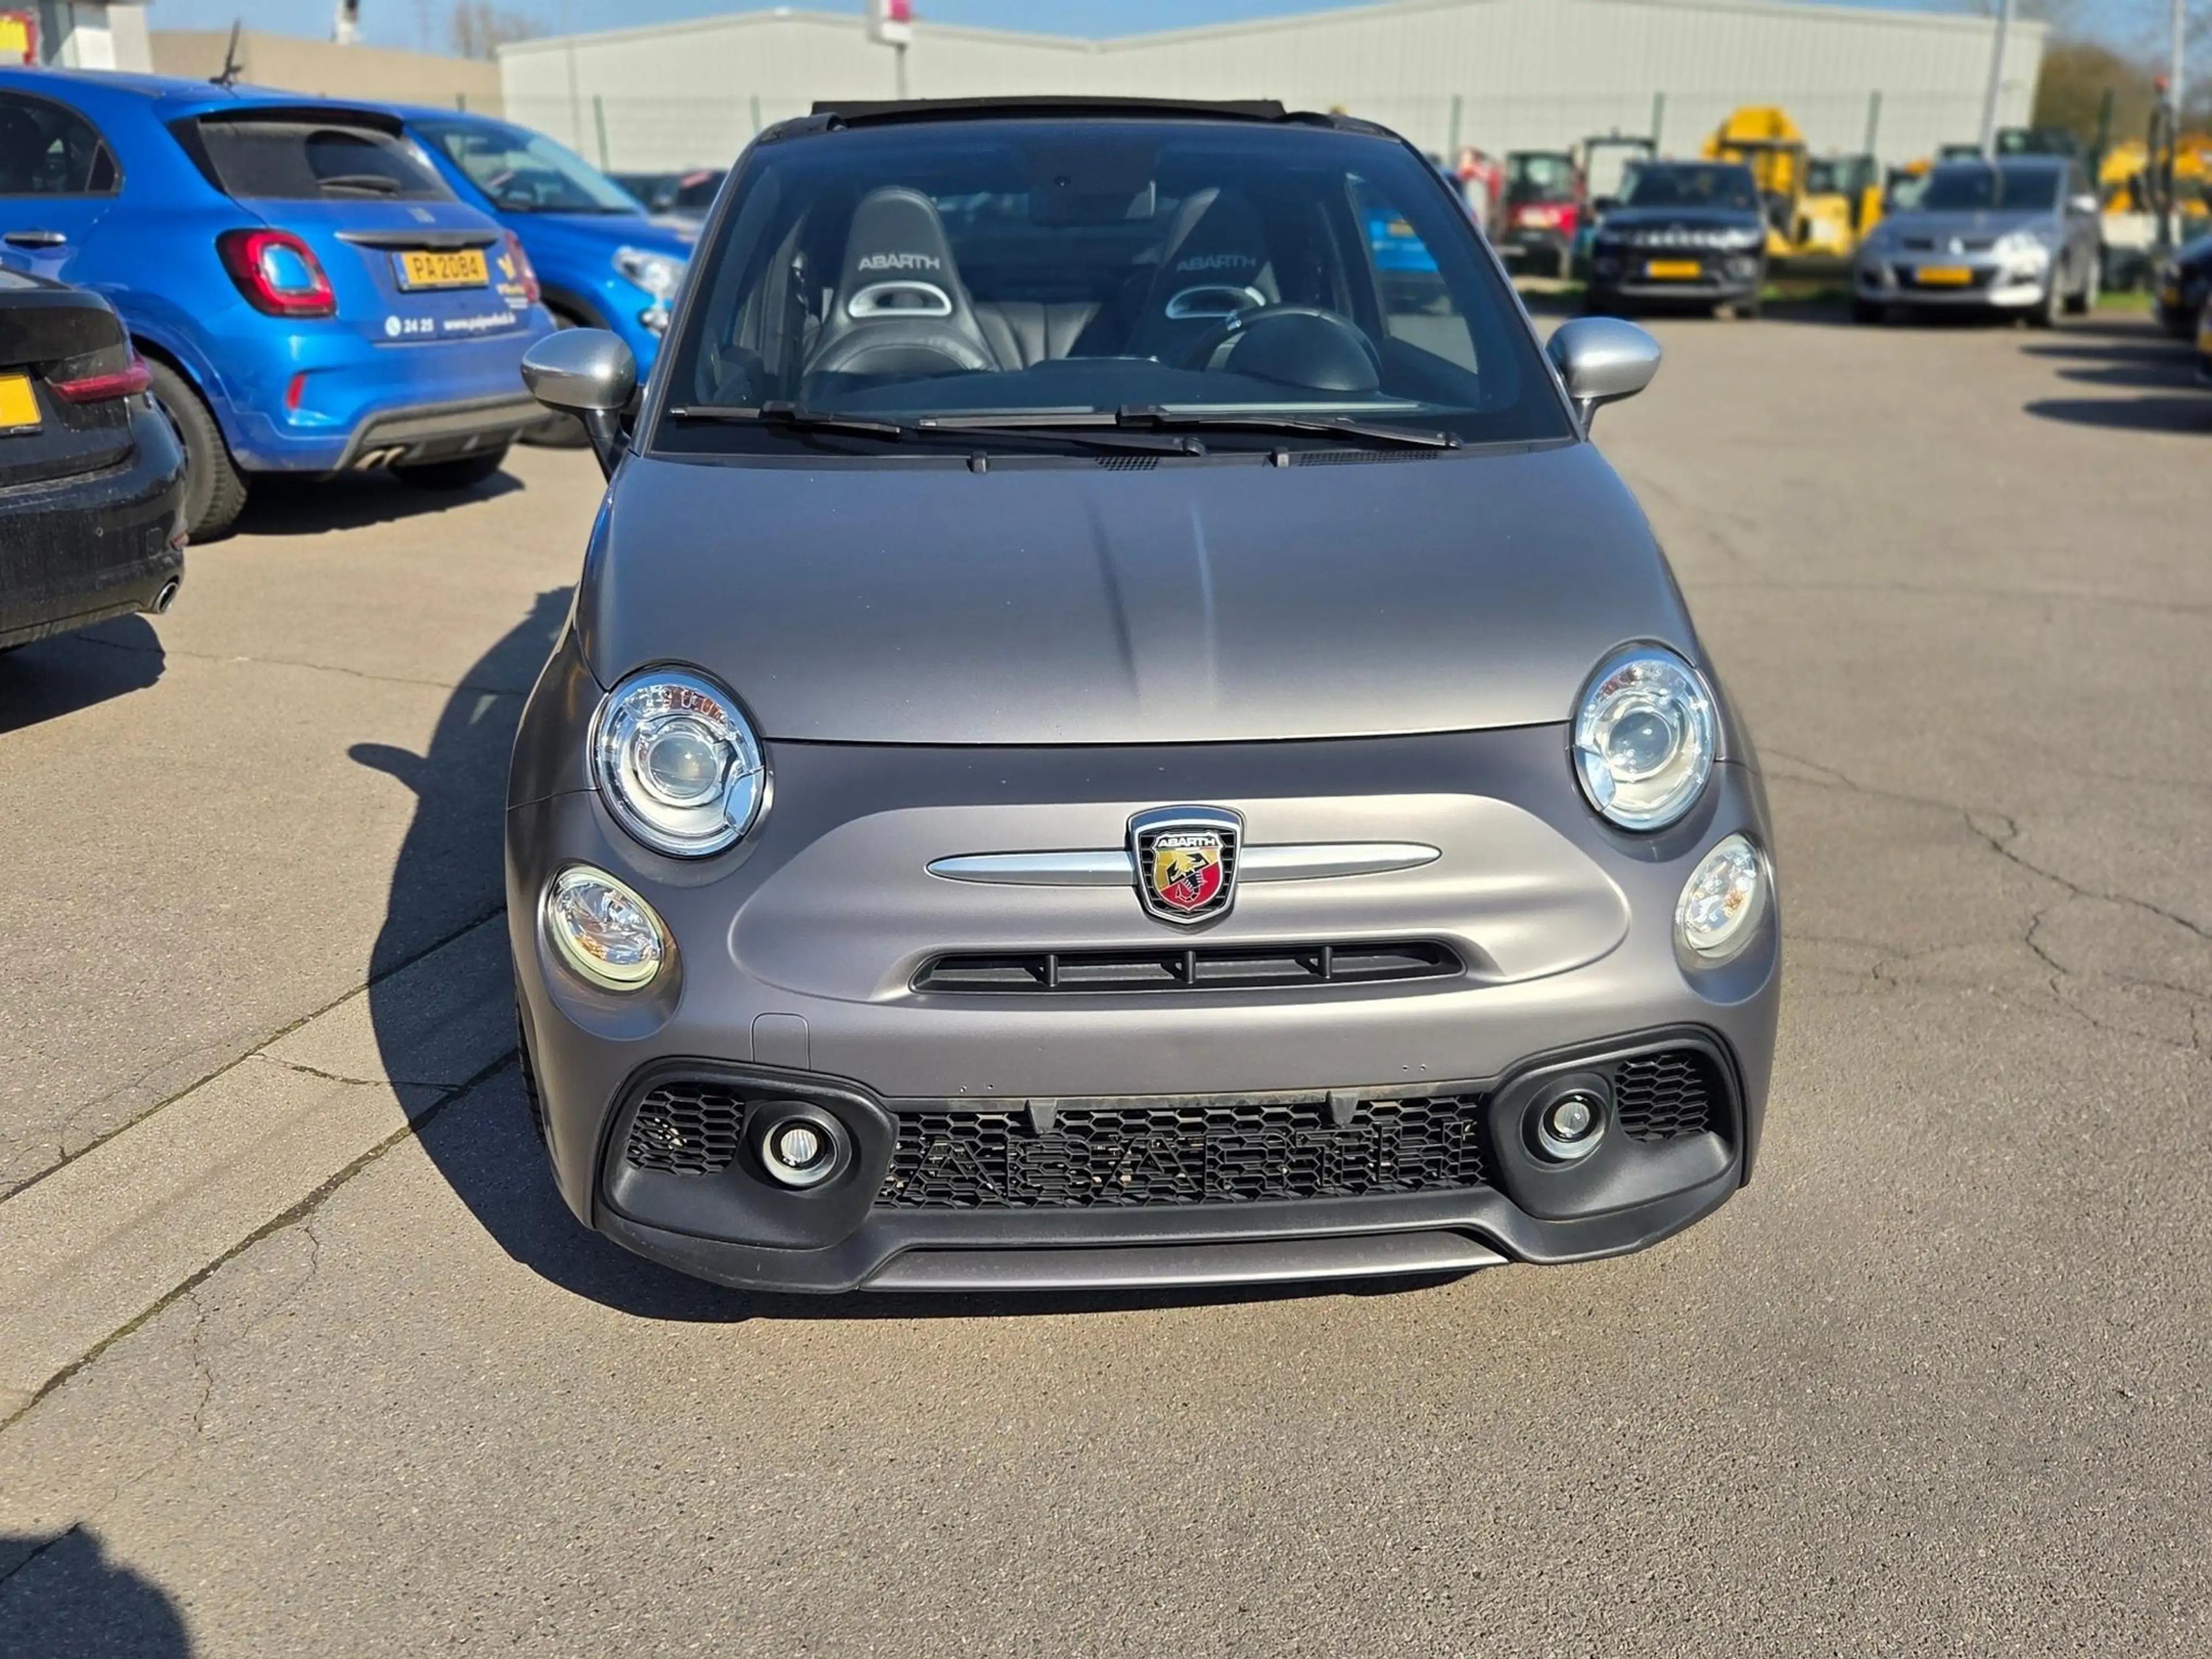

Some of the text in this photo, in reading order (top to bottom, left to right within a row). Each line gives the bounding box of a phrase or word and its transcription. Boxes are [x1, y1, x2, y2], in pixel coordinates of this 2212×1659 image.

[413, 255, 479, 279] PA 2084
[858, 253, 940, 271] ABARTH
[1176, 255, 1256, 272] ABARTH
[1158, 837, 1215, 847] ABARTH
[901, 1121, 1464, 1199] ABARTH
